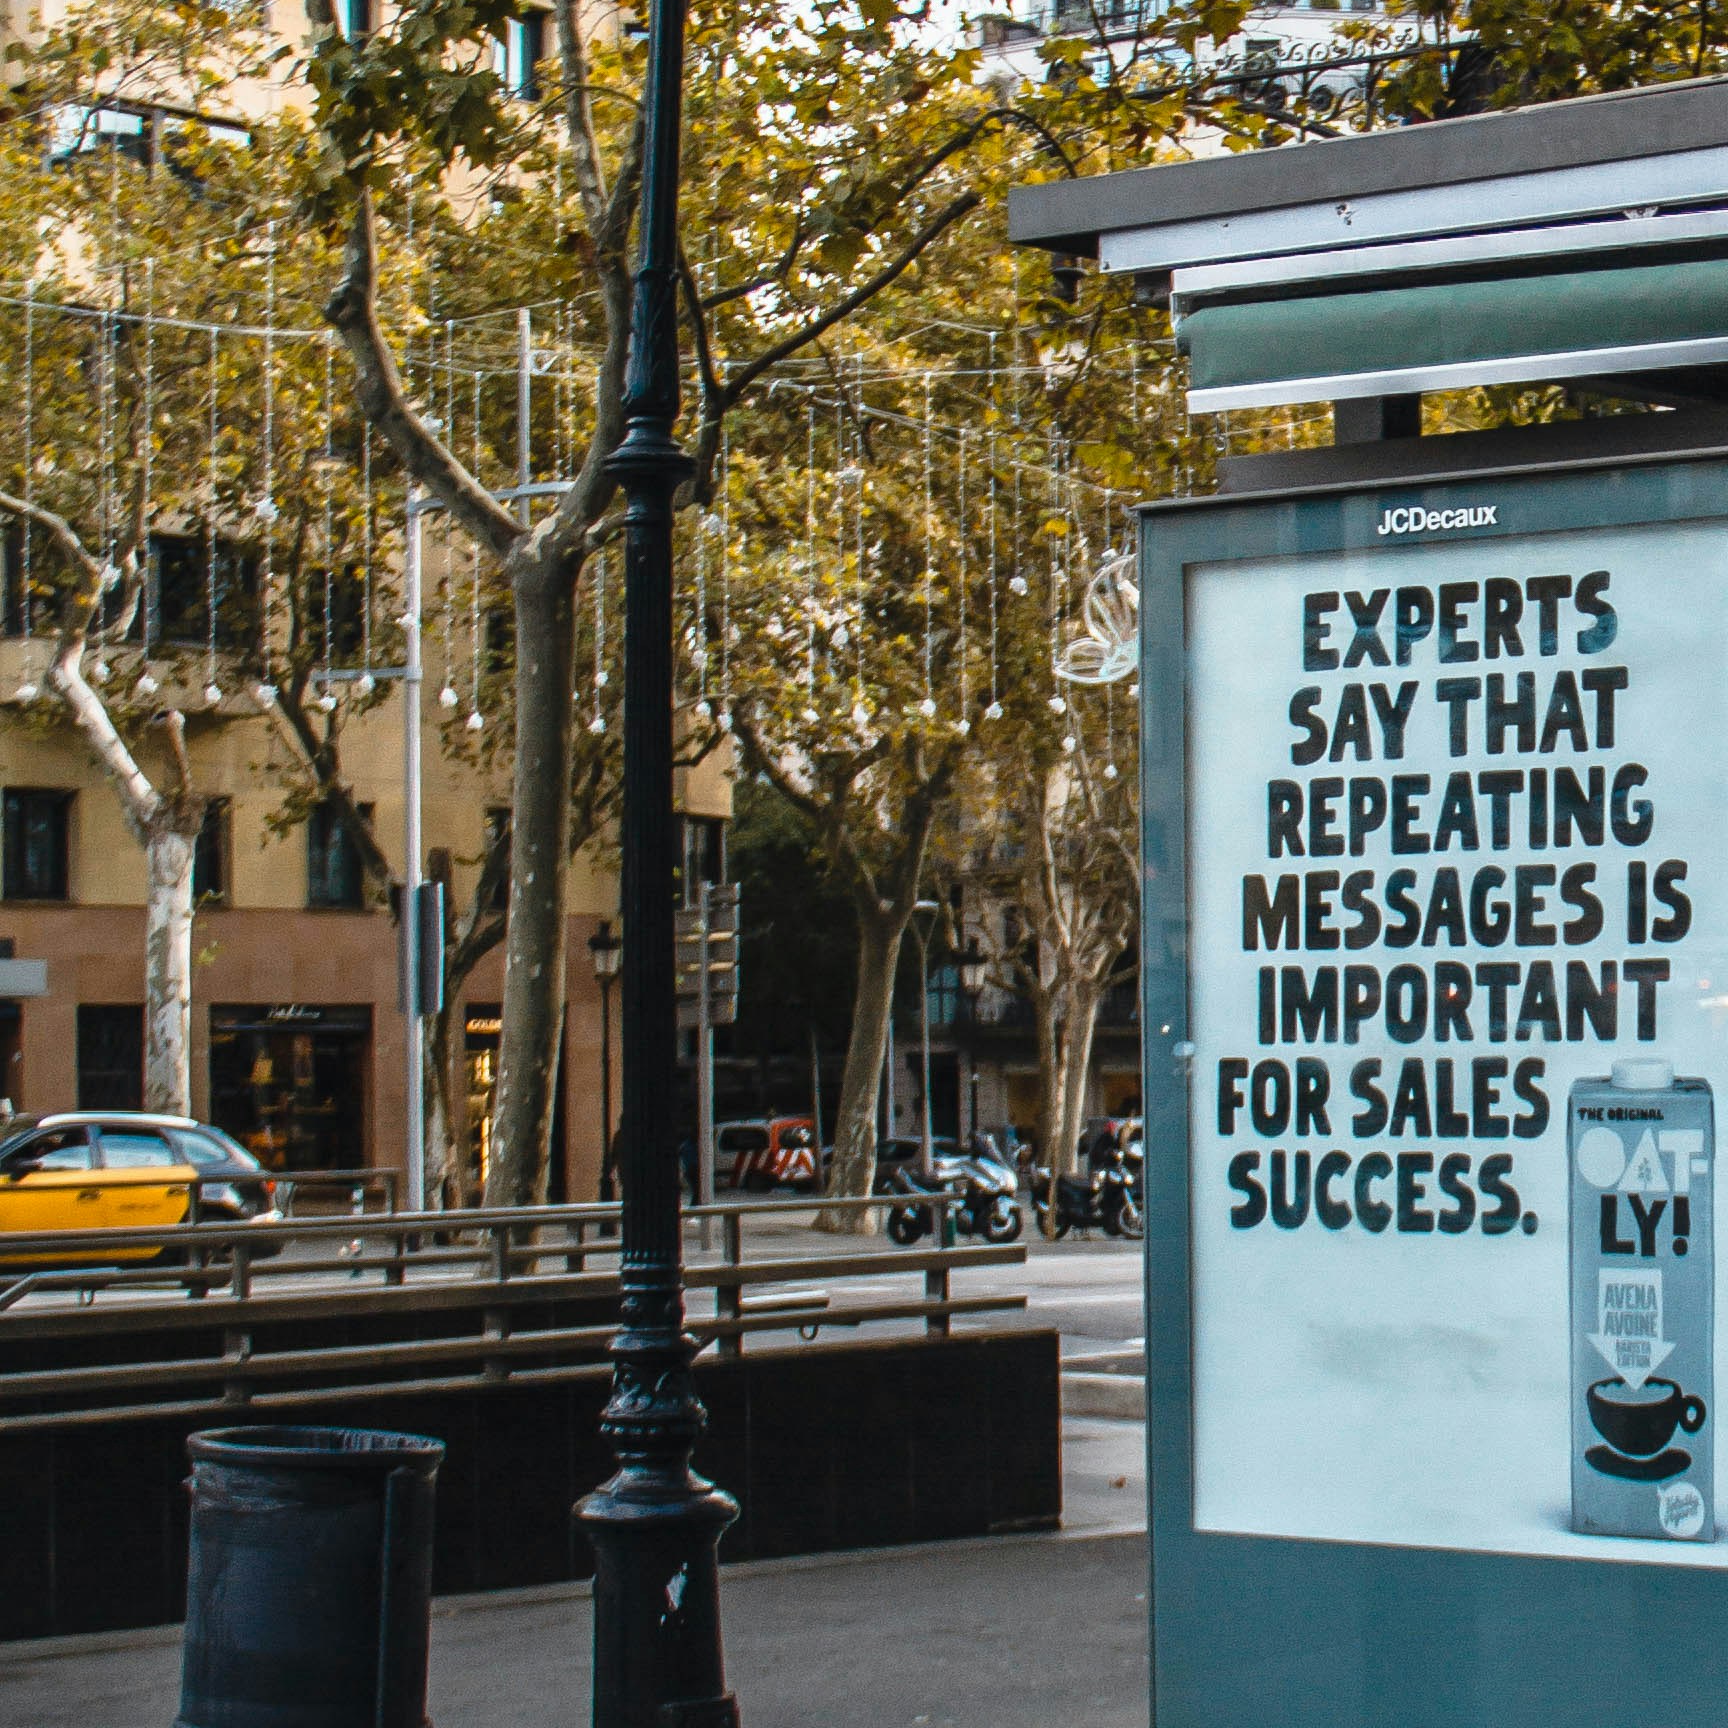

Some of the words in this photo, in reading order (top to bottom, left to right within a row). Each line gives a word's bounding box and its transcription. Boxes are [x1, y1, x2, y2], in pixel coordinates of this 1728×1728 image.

[1377, 503, 1498, 537] JCDecaux
[1302, 570, 1619, 672] EXPERTS
[1288, 680, 1418, 767] SAY
[1435, 666, 1629, 758] THAT
[1267, 762, 1655, 860] REPEATING
[1241, 862, 1605, 952] MESSAGES
[1627, 858, 1693, 947] IS
[1257, 957, 1672, 1046] IMPORTANT
[1216, 1056, 1332, 1139] FOR
[1350, 1055, 1551, 1140] SALES
[1577, 1106, 1605, 1122] THE
[1606, 1106, 1665, 1122] ORIGINAL
[1227, 1149, 1539, 1236] SUCCESS.
[1600, 1191, 1691, 1258] LY!
[1604, 1283, 1658, 1310] AVENA
